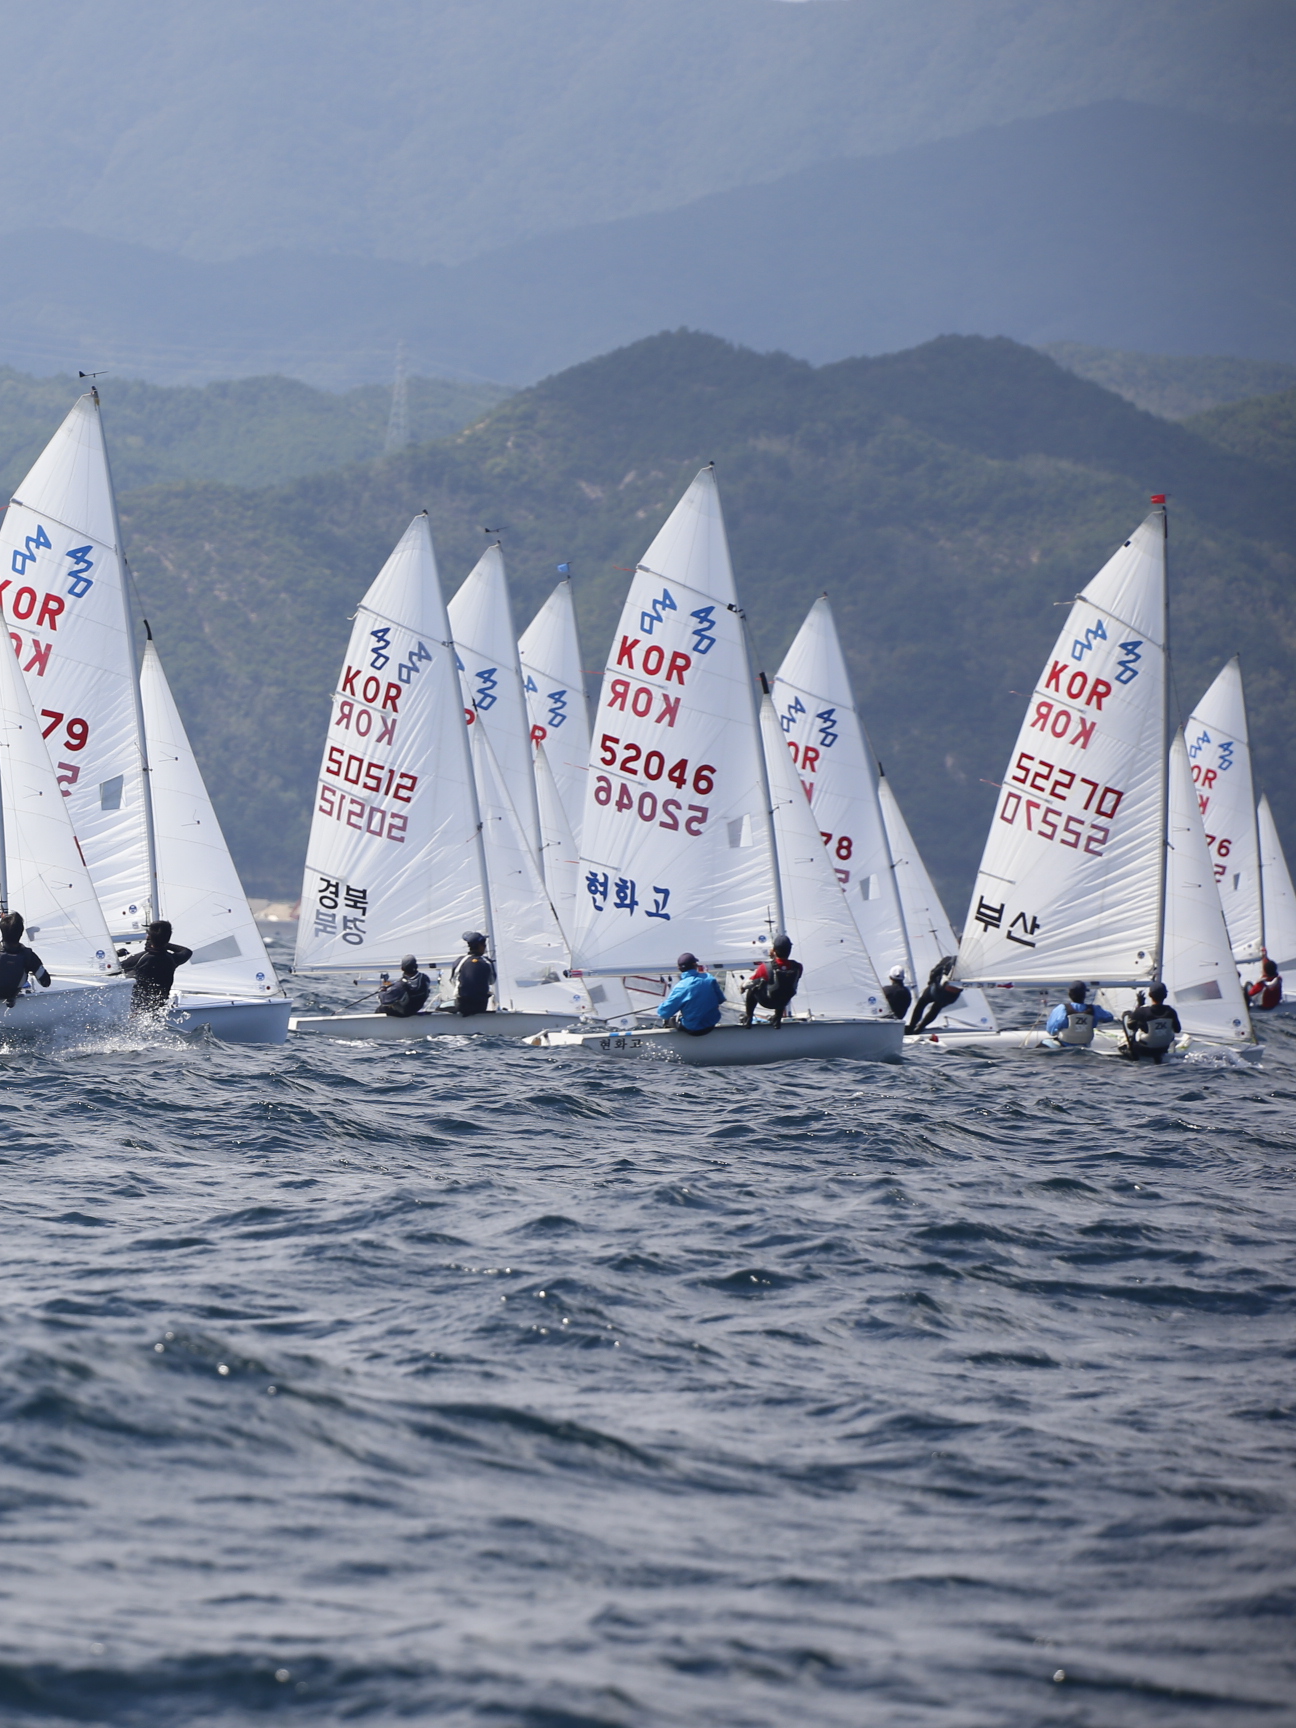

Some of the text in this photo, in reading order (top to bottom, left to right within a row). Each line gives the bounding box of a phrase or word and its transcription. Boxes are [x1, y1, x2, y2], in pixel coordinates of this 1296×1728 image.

[616, 635, 692, 686] KOR
[1045, 660, 1112, 711] KOR
[341, 665, 402, 713] KOR
[326, 746, 418, 803] 50512
[600, 733, 717, 795] 52046
[1011, 752, 1124, 819] 52270
[318, 877, 368, 916] 경북
[585, 870, 671, 921] 현화고
[974, 895, 1040, 948] 부산
